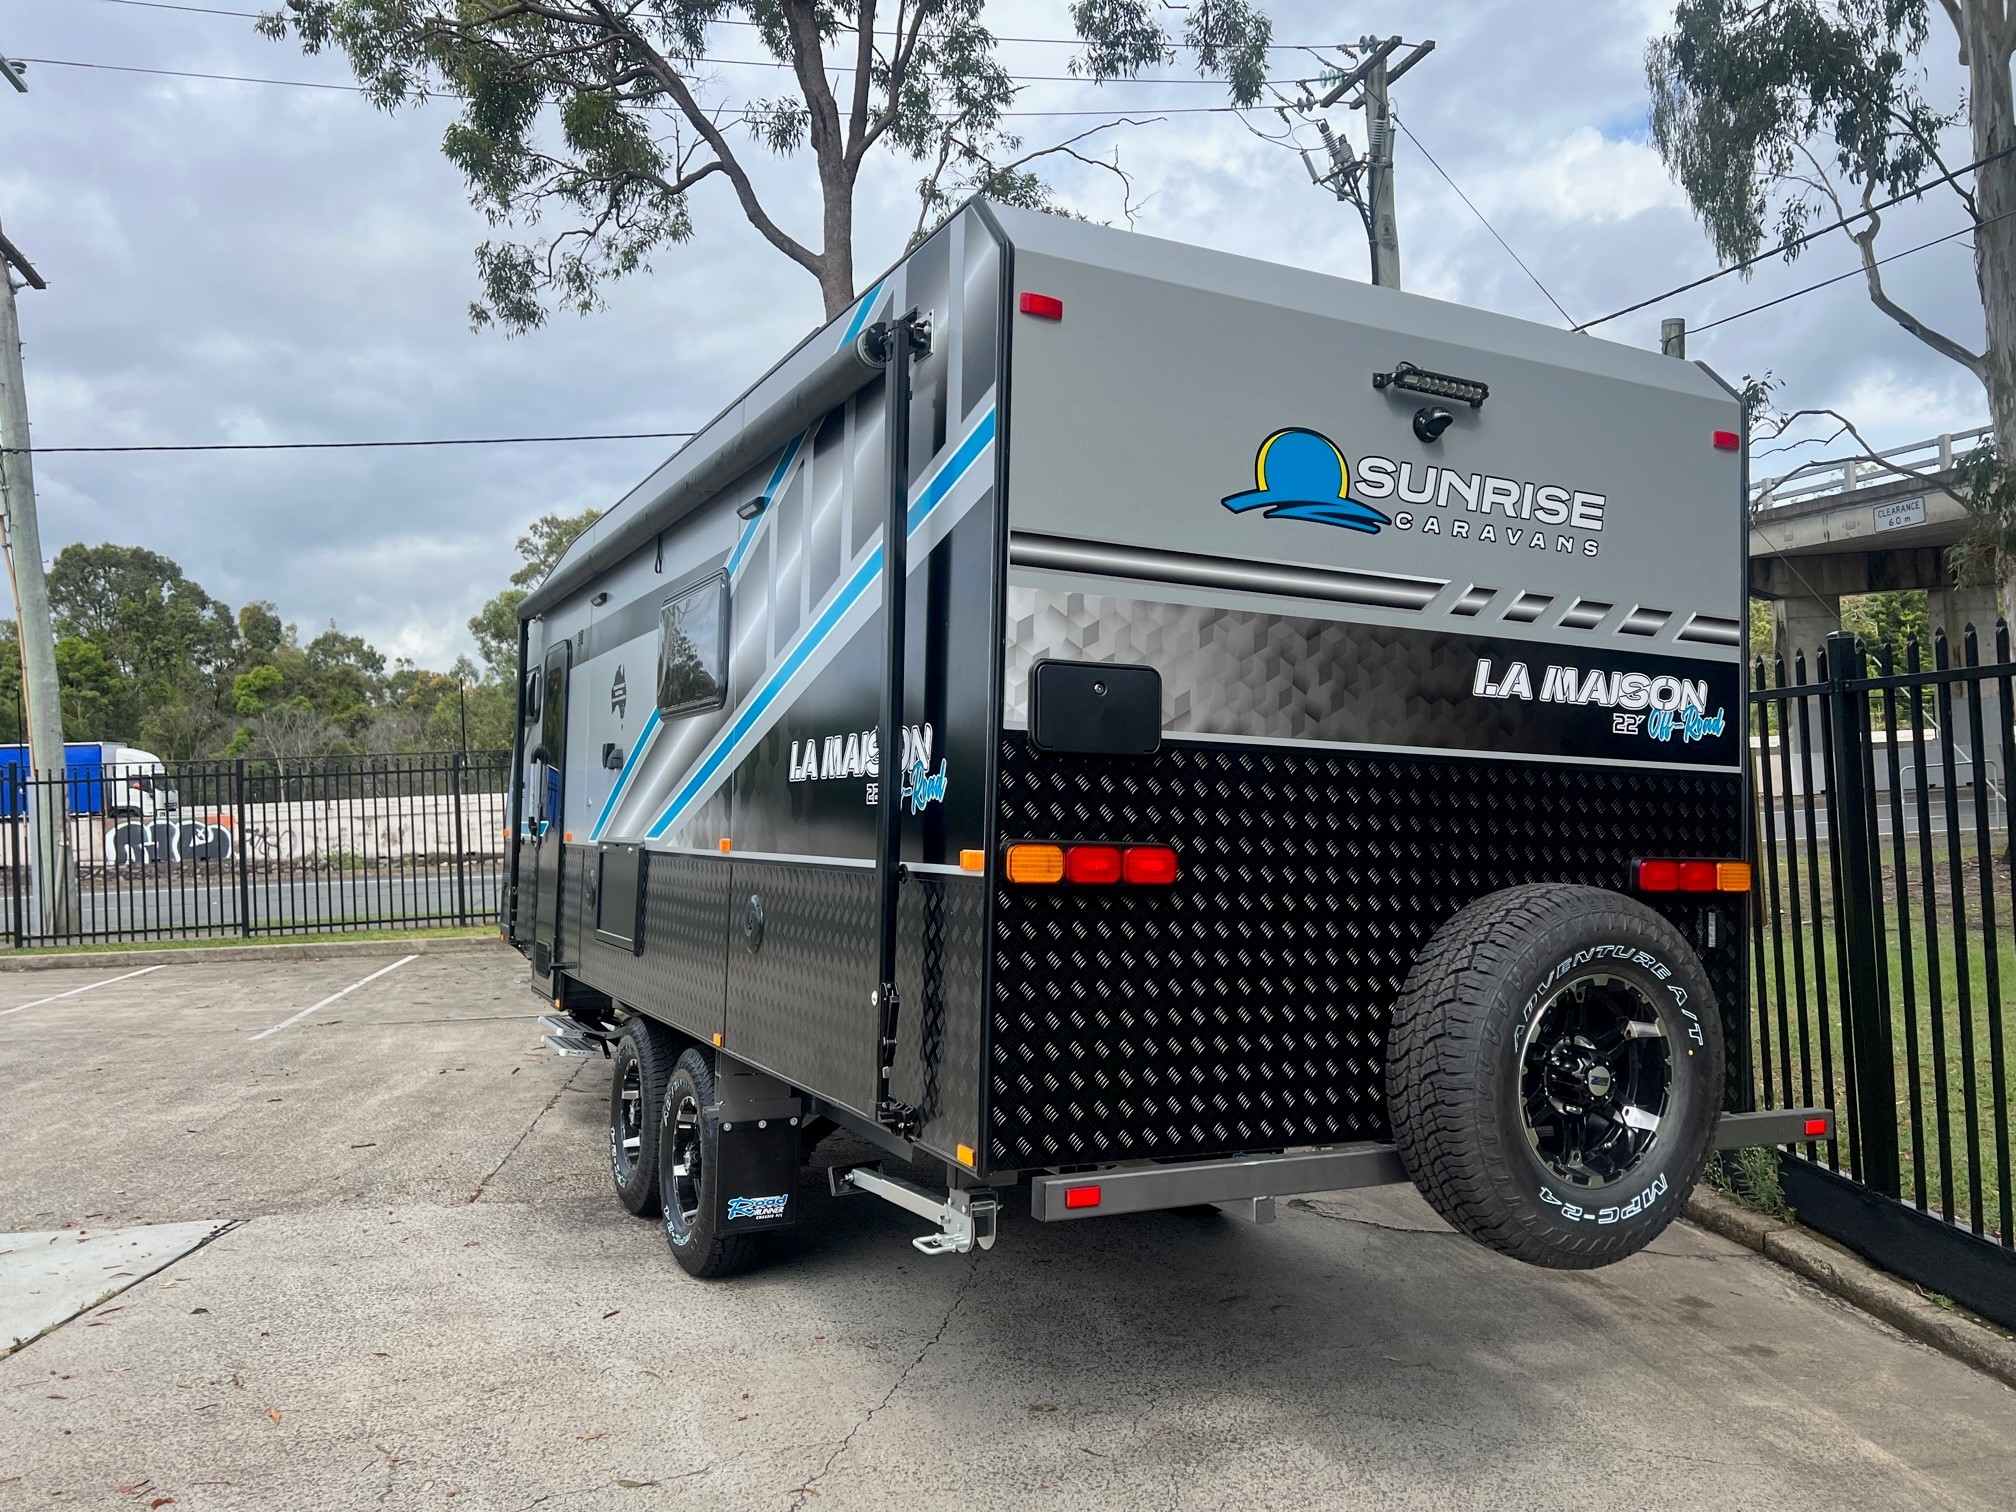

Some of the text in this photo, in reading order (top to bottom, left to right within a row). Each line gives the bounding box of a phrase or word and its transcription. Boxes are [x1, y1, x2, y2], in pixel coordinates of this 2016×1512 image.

[1354, 455, 1606, 531] SUNRISE
[1877, 501, 1921, 518] CLEARANCE
[1394, 512, 1600, 557] CARAVANS
[1473, 659, 1708, 714] LA MAISON
[1648, 705, 1725, 743] Off-Road
[789, 739, 818, 782] LA
[1513, 944, 1704, 1053] ADVENTURE A/T
[728, 1194, 788, 1220] Road
[1539, 1172, 1668, 1224] MPC-24
